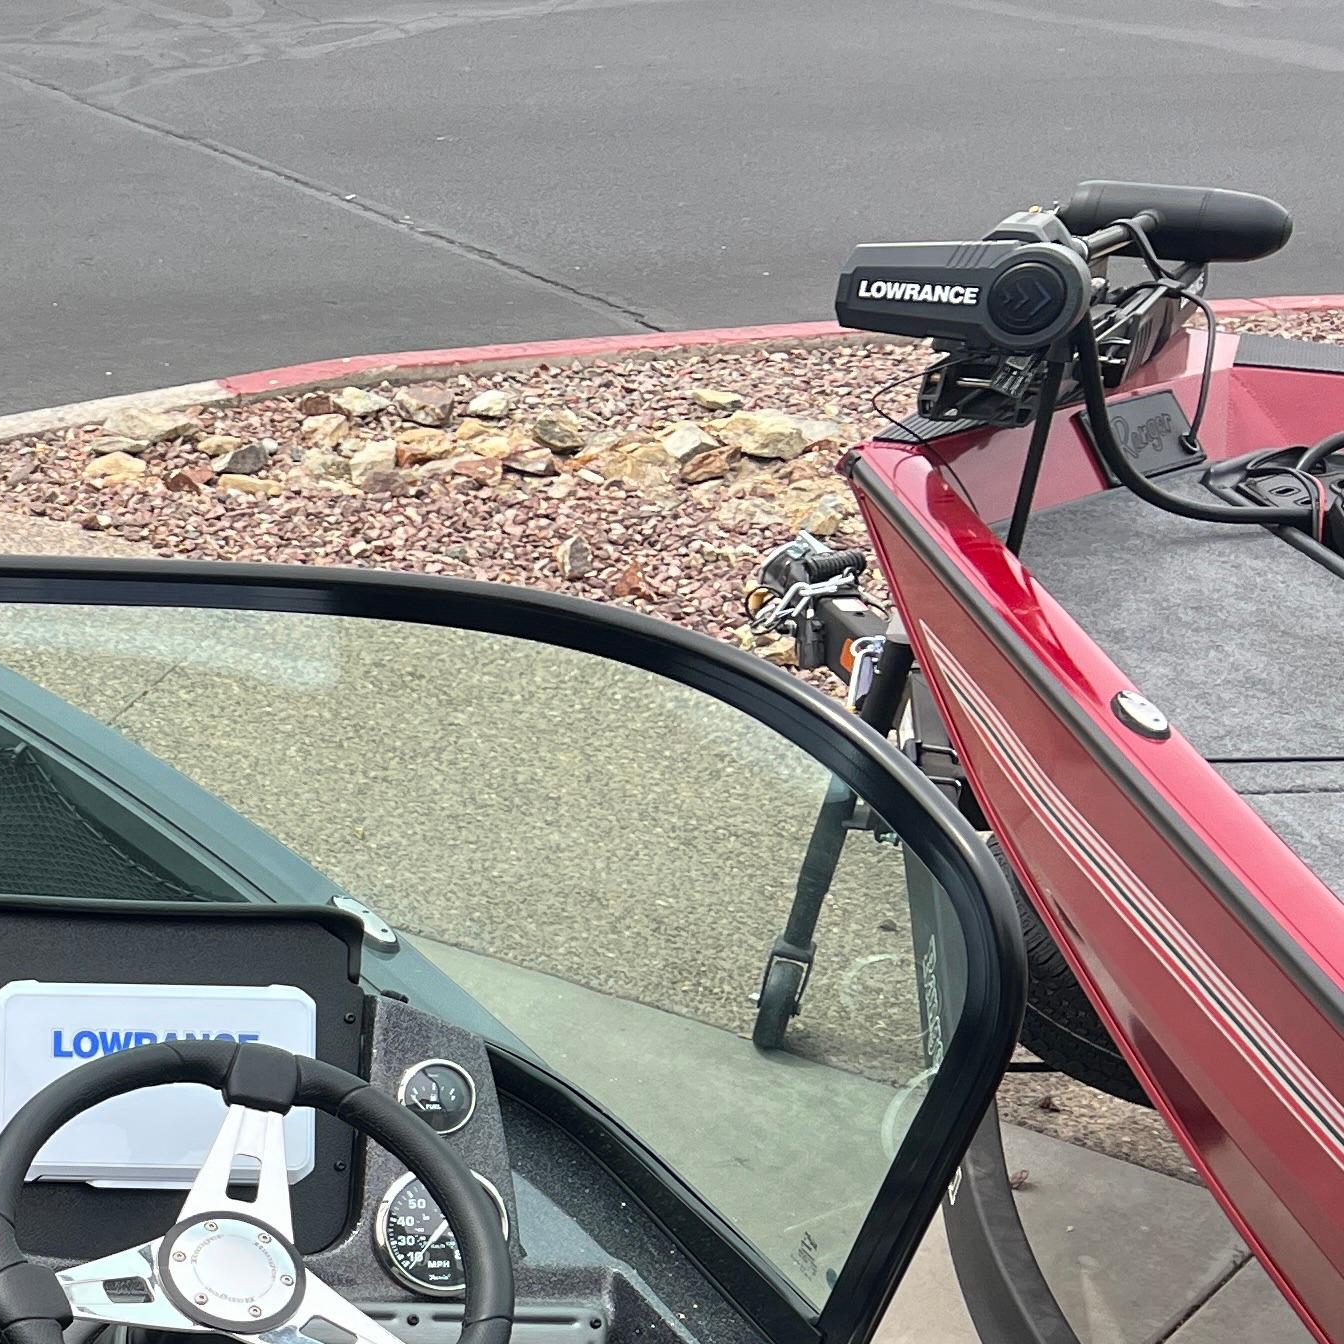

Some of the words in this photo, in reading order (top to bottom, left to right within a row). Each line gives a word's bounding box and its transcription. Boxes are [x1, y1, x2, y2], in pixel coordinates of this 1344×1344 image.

[858, 280, 979, 304] LOWRANCE
[408, 1199, 426, 1209] 50
[396, 1216, 415, 1226] 40
[397, 1236, 416, 1246] 30
[427, 1260, 451, 1268] MPH
